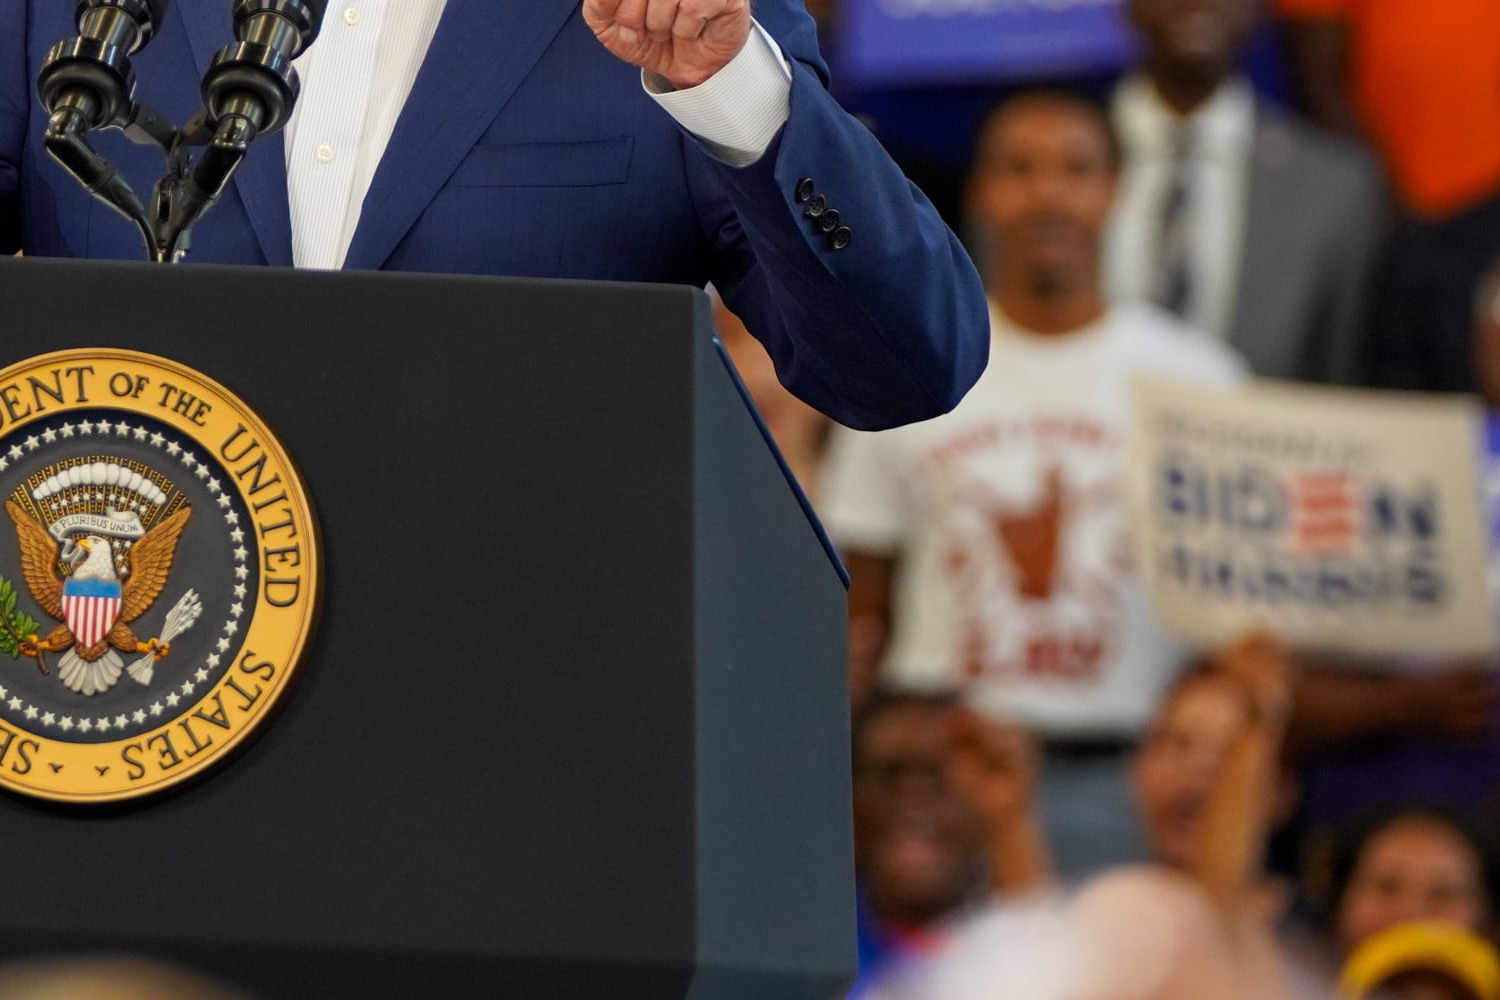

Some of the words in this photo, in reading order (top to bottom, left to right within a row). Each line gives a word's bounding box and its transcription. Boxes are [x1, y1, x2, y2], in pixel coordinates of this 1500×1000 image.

[109, 371, 150, 400] OF
[159, 382, 212, 428] THE
[59, 515, 108, 529] PLURIBUS
[110, 520, 139, 533] UNUM
[219, 422, 301, 609] UNITED
[1160, 455, 1442, 552] BIDEN
[121, 649, 276, 781] STATES
